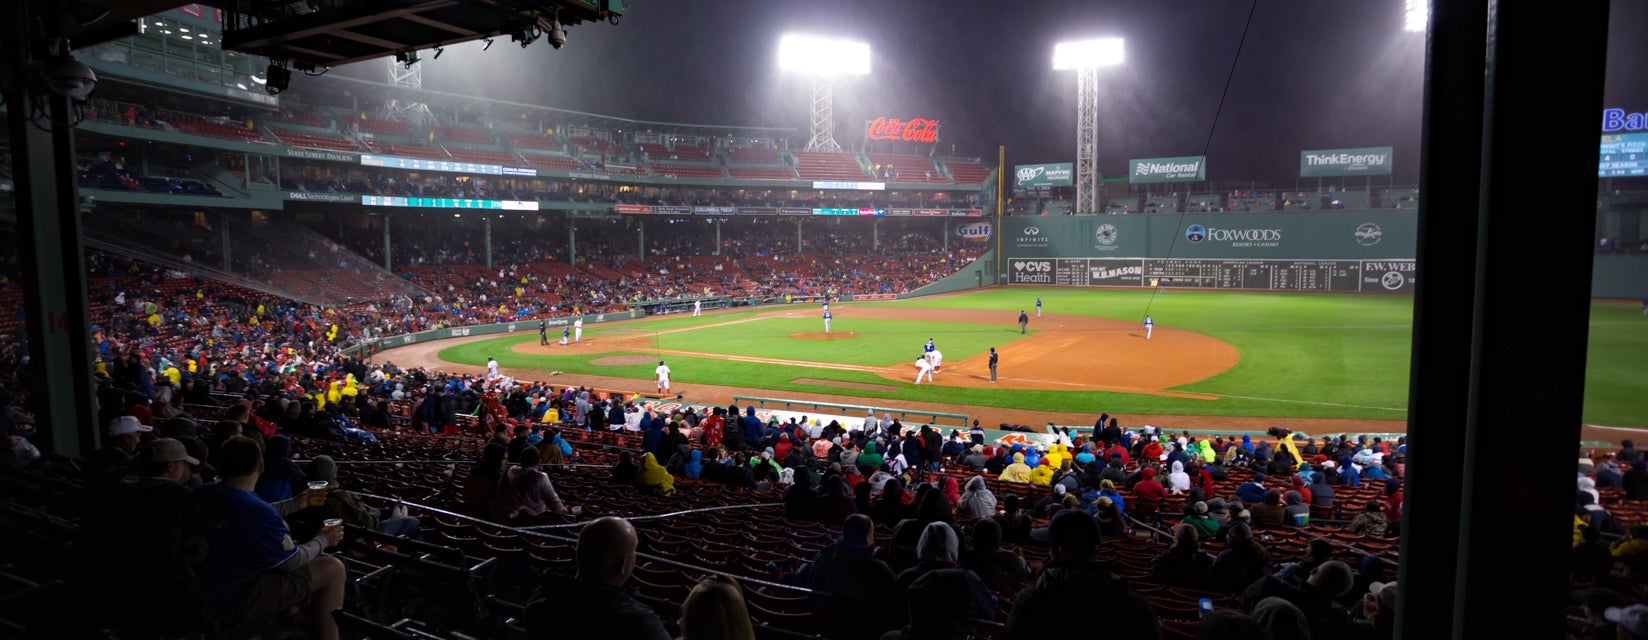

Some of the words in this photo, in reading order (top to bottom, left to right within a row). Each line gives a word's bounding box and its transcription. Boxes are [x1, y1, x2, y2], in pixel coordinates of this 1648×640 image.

[1602, 108, 1648, 132] Ba
[868, 117, 939, 142] Coca-Cola
[287, 150, 305, 158] STATE
[326, 153, 353, 162] PAVILION
[1306, 153, 1384, 166] ThinkEnergy
[1150, 162, 1199, 174] National
[307, 193, 339, 201] Technologies
[958, 226, 990, 235] Gulf
[1208, 228, 1280, 241] FOXWOODS
[1026, 262, 1051, 272] CVS
[1015, 272, 1051, 282] Health
[48, 312, 69, 334] 14
